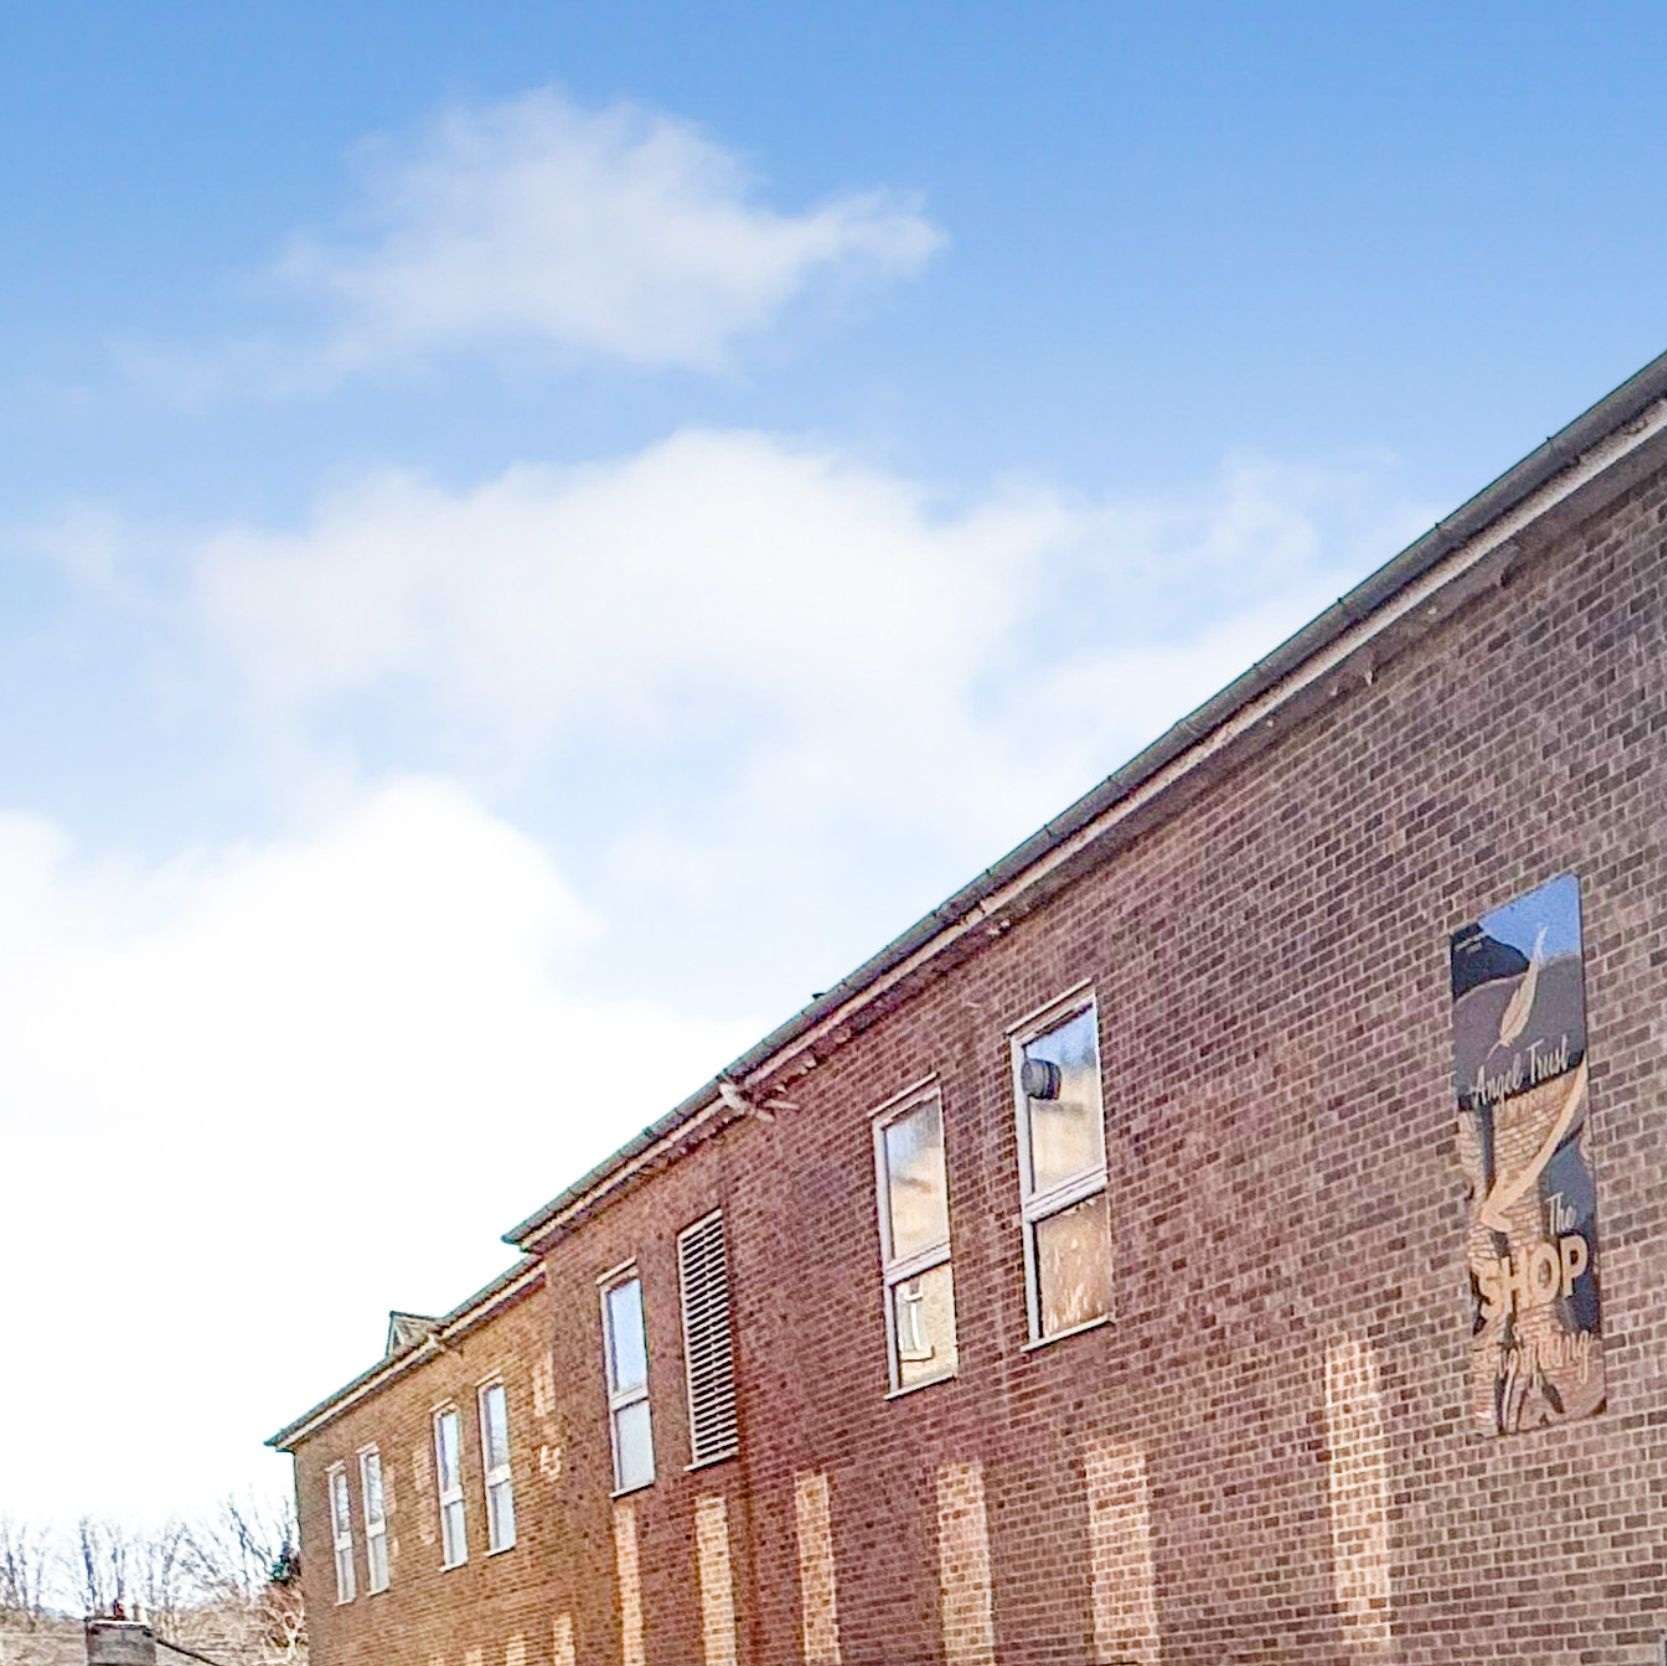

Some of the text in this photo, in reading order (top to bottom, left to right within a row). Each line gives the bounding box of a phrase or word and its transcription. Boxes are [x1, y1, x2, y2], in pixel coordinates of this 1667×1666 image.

[1469, 1033, 1570, 1112] Angel Trust
[1545, 1192, 1578, 1235] The
[1472, 1236, 1588, 1320] SHOP
